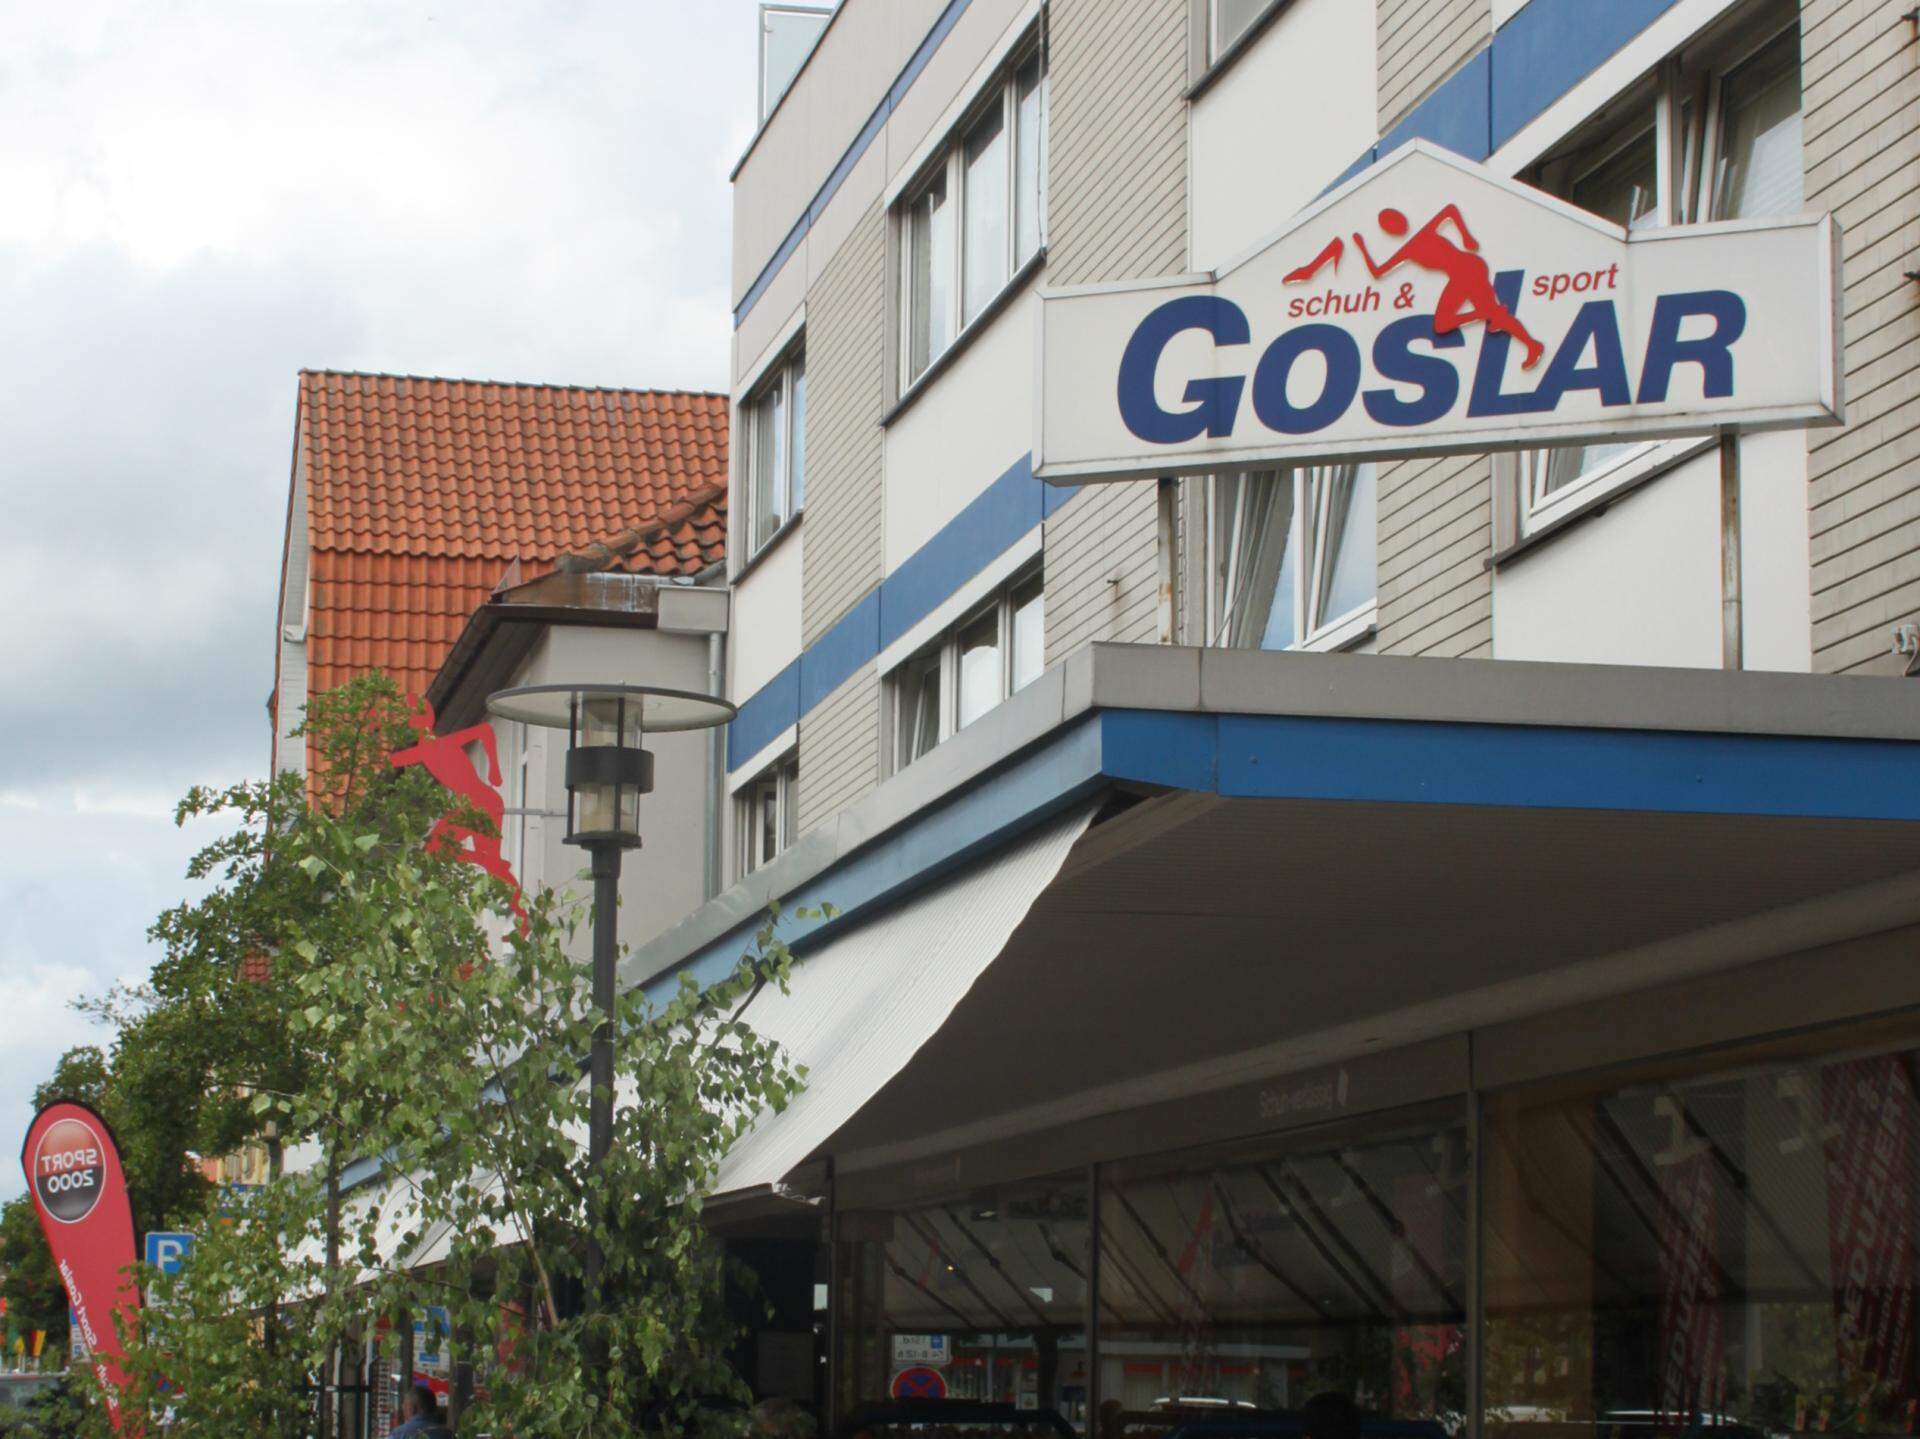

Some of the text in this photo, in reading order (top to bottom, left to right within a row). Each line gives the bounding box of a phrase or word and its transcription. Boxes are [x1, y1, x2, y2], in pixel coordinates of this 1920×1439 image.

[1287, 264, 1620, 319] schuh & sport
[1117, 269, 1747, 446] GOSLAR
[157, 1239, 183, 1274] P
